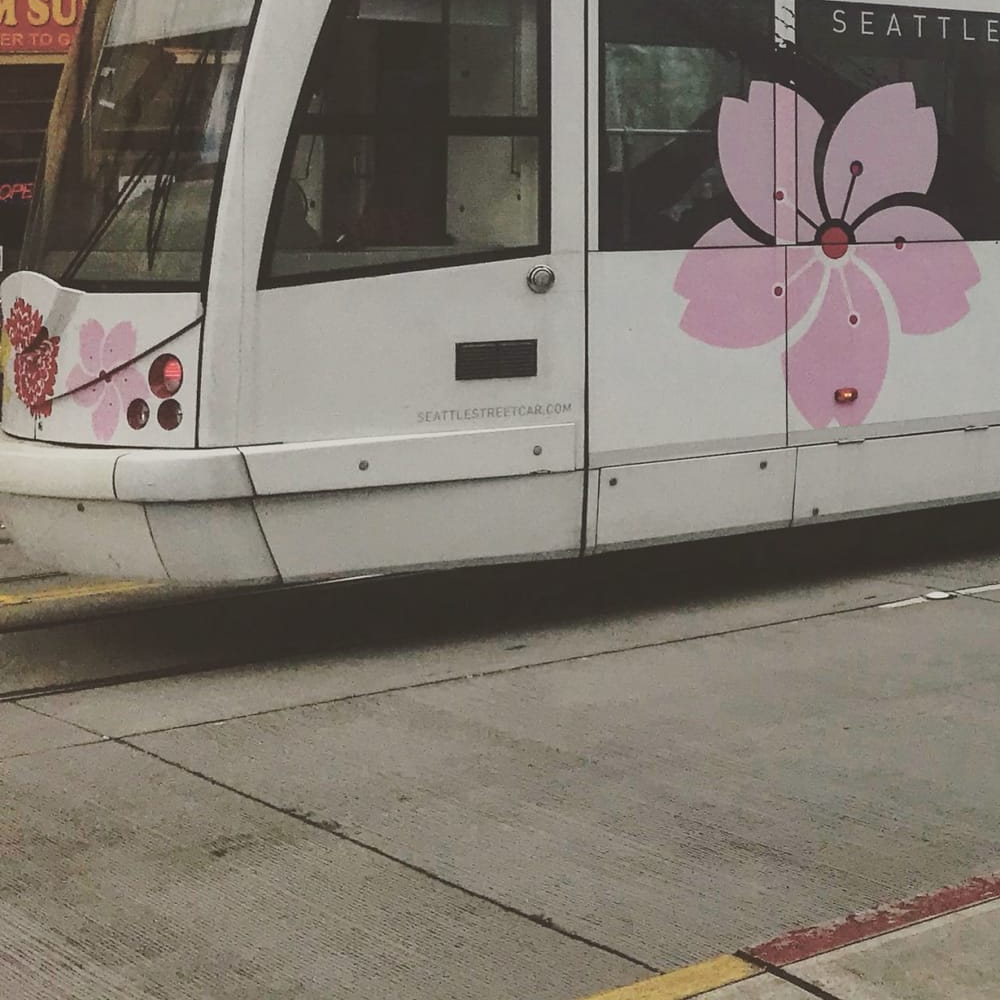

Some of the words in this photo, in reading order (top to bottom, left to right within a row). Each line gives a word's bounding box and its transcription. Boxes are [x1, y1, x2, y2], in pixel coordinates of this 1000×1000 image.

[832, 9, 1000, 43] SEATTLE
[29, 33, 53, 47] TO
[416, 403, 573, 424] SEATTLESTREETCAR.COM
